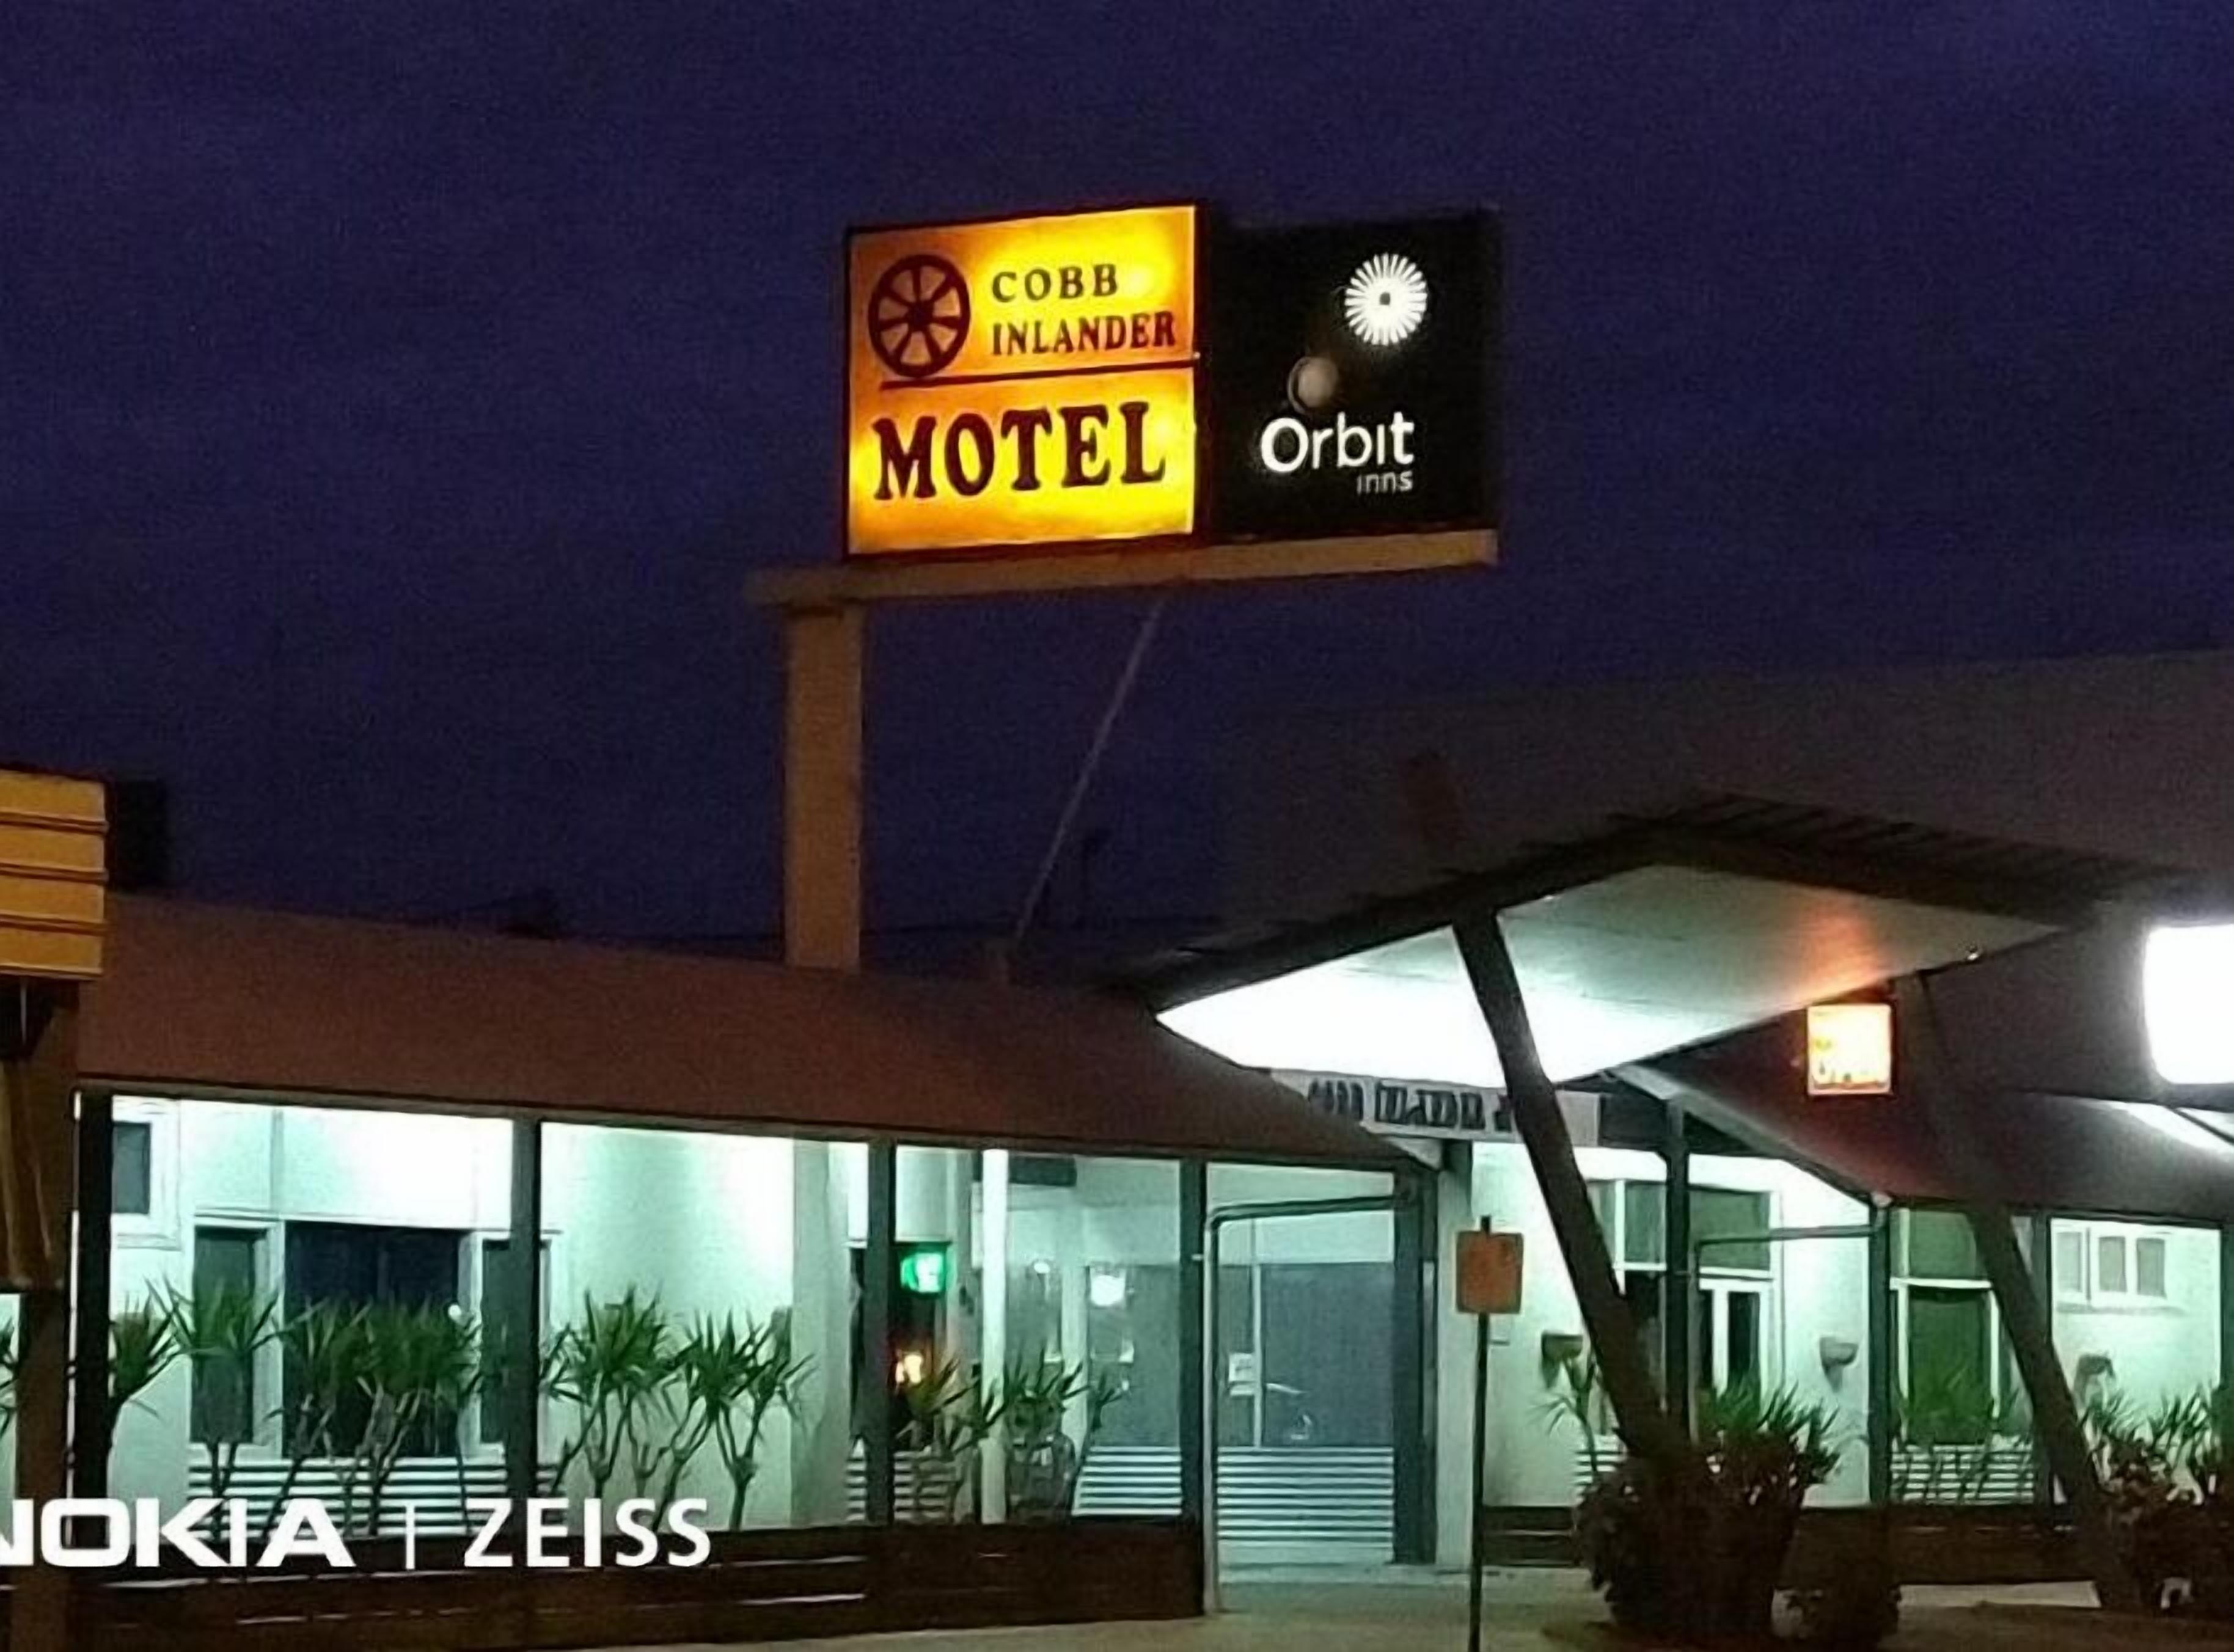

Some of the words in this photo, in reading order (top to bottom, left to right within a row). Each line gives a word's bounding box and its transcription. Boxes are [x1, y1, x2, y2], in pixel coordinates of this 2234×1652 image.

[991, 263, 1118, 303] COBB
[991, 310, 1176, 355] INLANDER
[872, 401, 1166, 500] MOTEL
[1260, 411, 1415, 474] Orbit
[1357, 470, 1413, 493] inns
